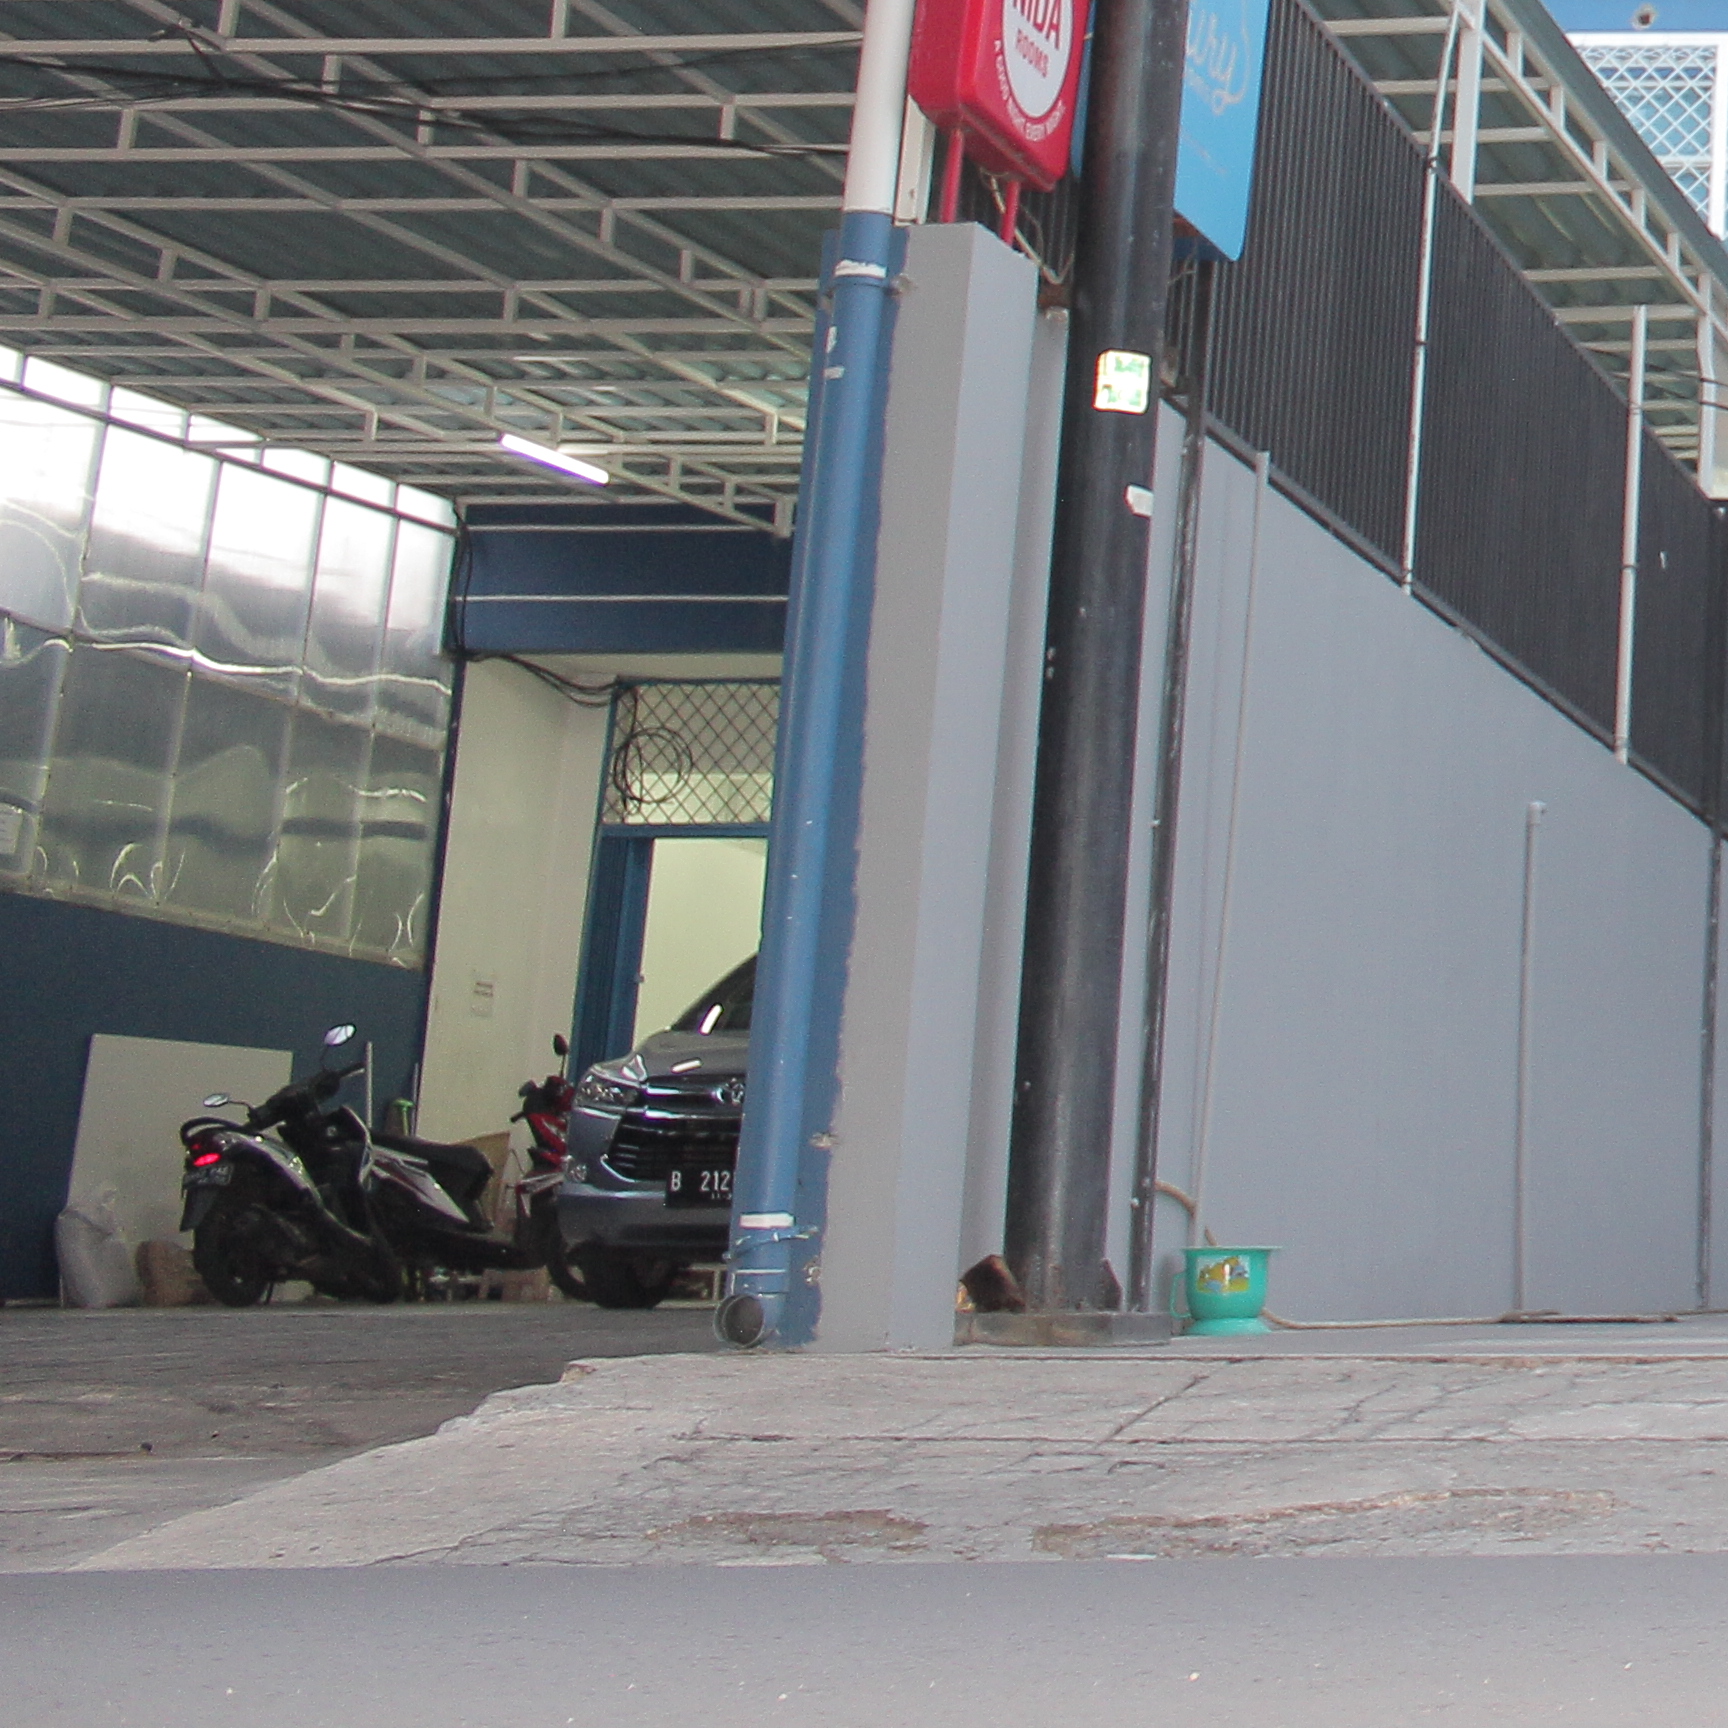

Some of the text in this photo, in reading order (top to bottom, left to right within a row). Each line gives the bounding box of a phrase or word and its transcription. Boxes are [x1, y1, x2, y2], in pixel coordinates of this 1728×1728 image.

[1015, 27, 1049, 79] ROOMS
[671, 1170, 732, 1191] B 212
